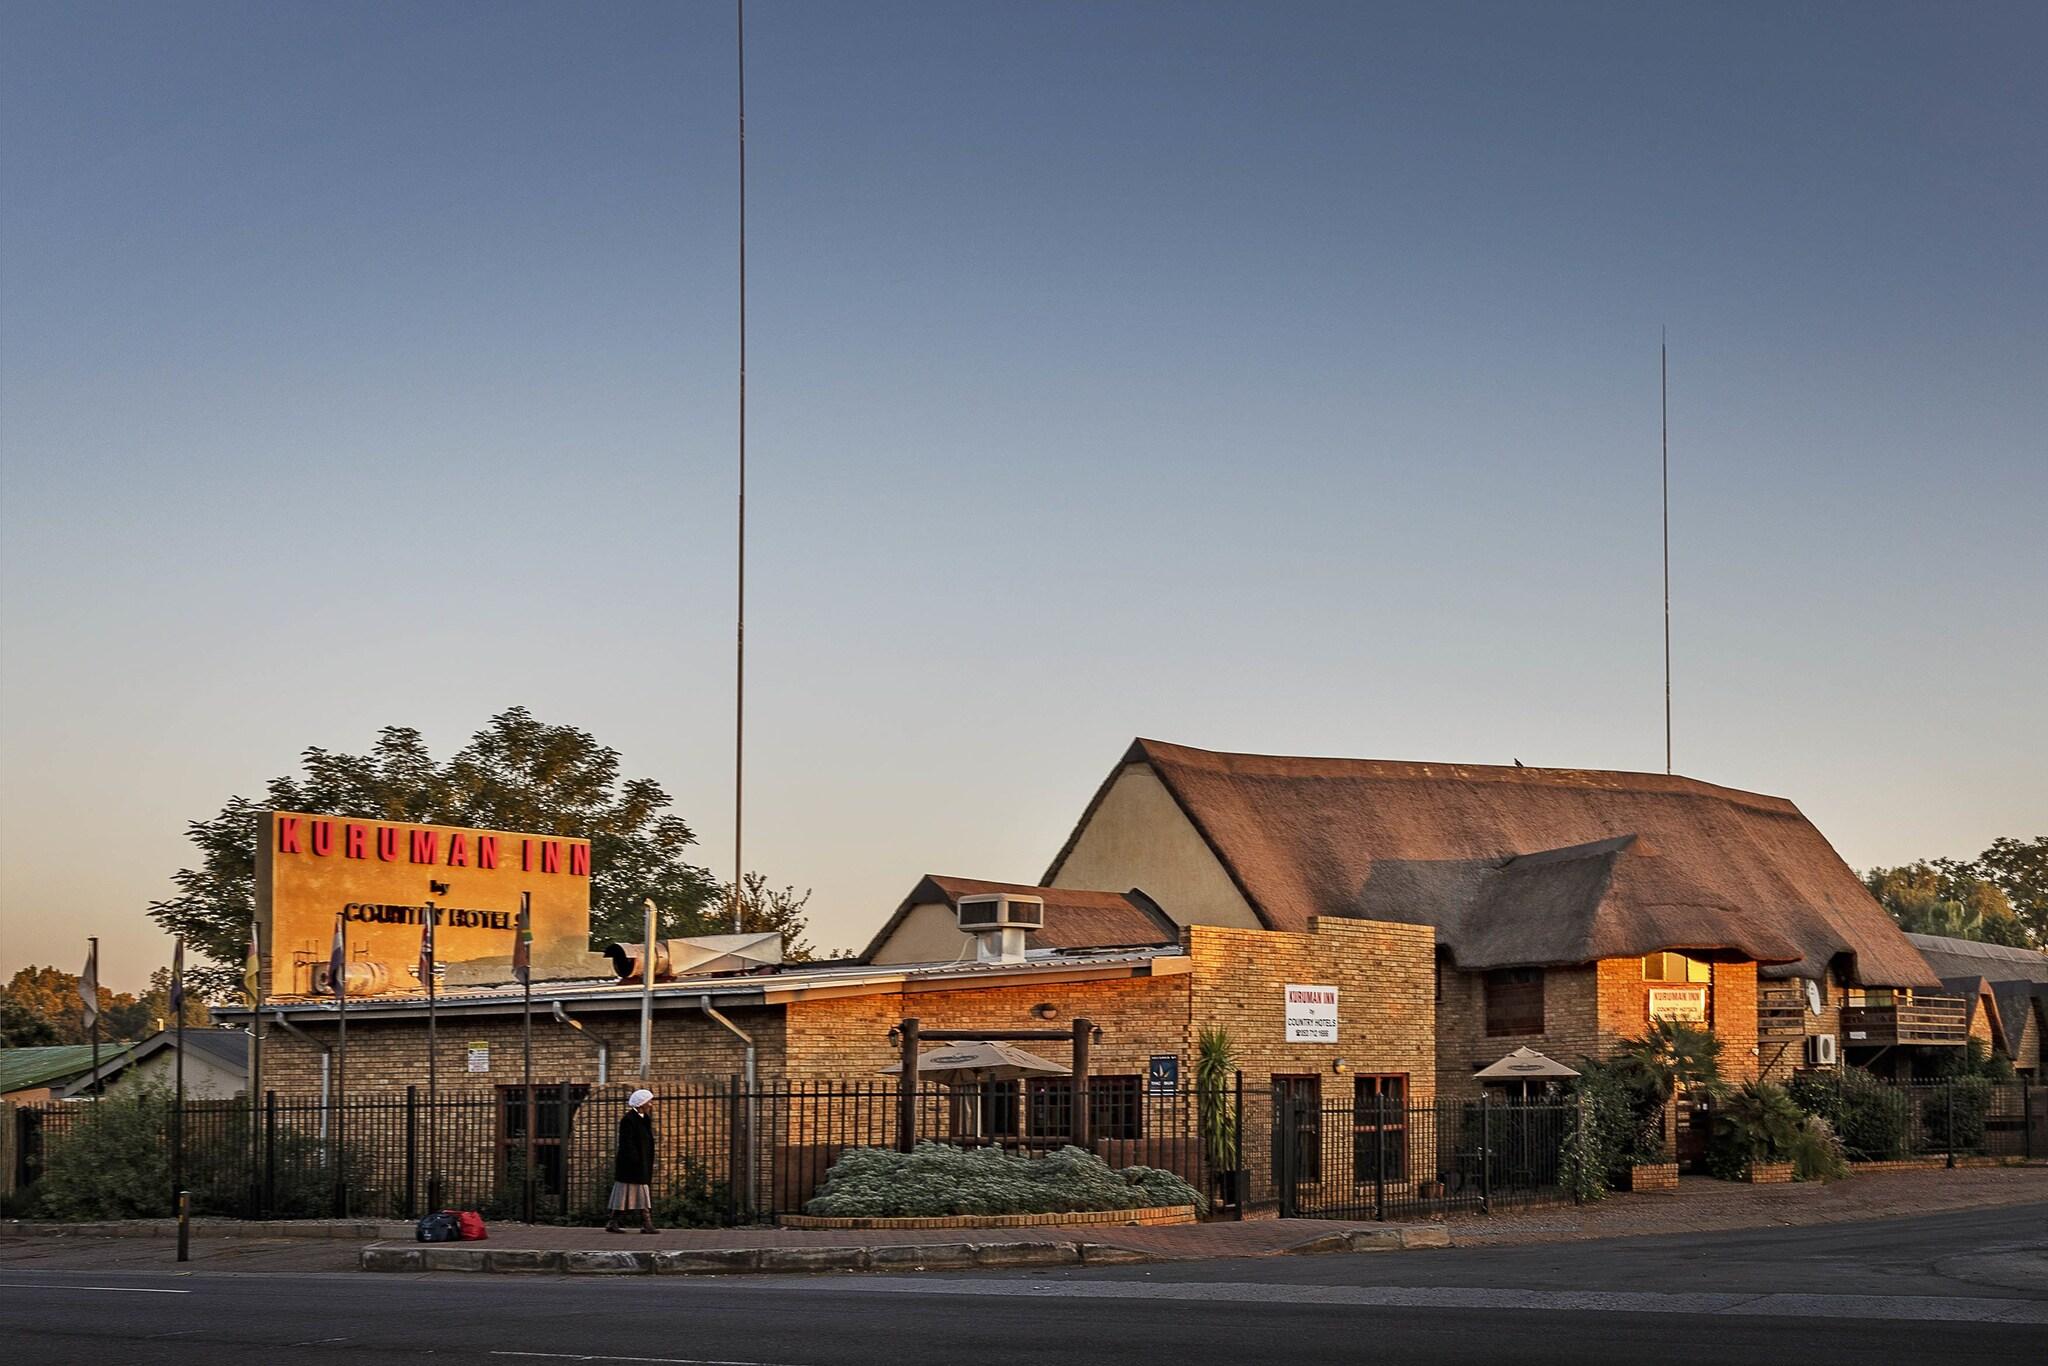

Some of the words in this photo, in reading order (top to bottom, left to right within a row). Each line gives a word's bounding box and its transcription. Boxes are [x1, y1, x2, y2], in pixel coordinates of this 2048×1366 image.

[279, 818, 498, 868] KURUMAN
[522, 838, 591, 876] INN
[430, 880, 450, 896] by
[1289, 991, 1321, 1003] KURUMAN
[1323, 992, 1335, 1004] INN
[1288, 1018, 1314, 1027] COUNTRY
[1315, 1018, 1336, 1027] HOTELS
